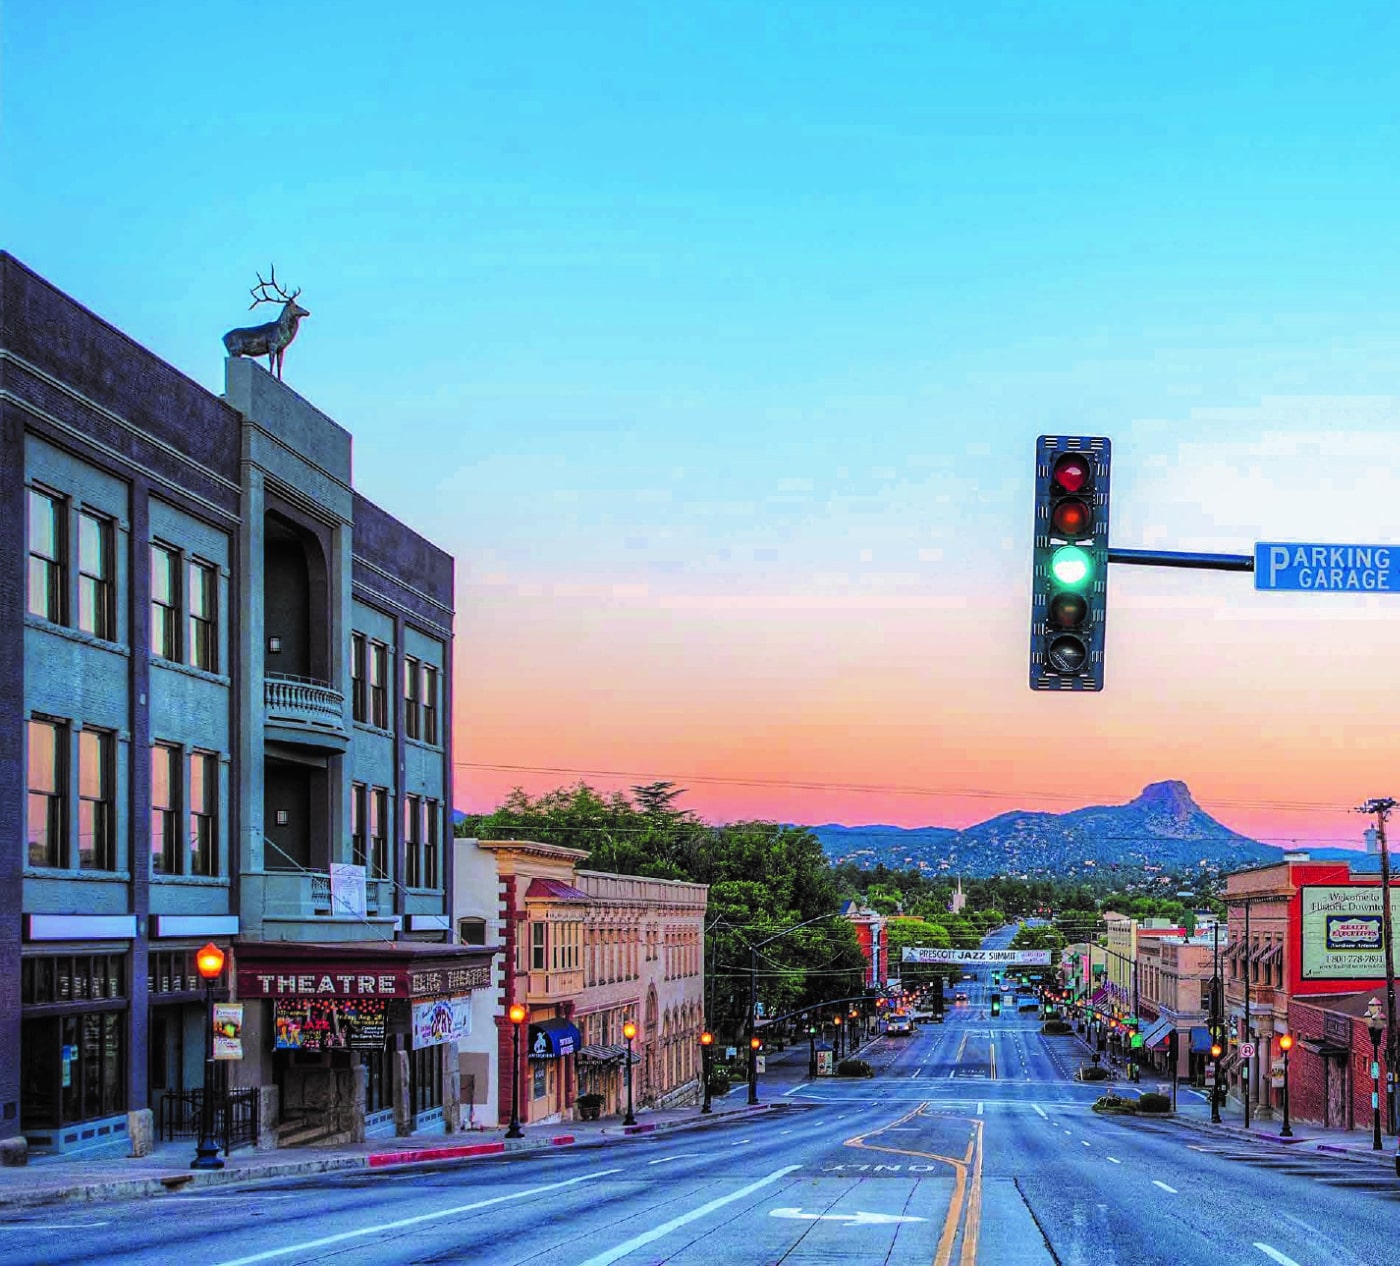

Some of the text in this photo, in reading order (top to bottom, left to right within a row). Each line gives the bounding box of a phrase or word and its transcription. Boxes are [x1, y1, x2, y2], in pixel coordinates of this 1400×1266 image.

[1269, 546, 1390, 588] PARKING
[1299, 569, 1390, 589] GARAGE
[1329, 892, 1380, 901] Welcome to
[1311, 902, 1397, 912] Historic Downton
[919, 950, 956, 959] PRESCOTT
[957, 952, 987, 960] JAZZ
[988, 952, 1016, 961] SUMMIT
[257, 975, 396, 994] THEATRE
[412, 967, 490, 993] ELKS THEATRE
